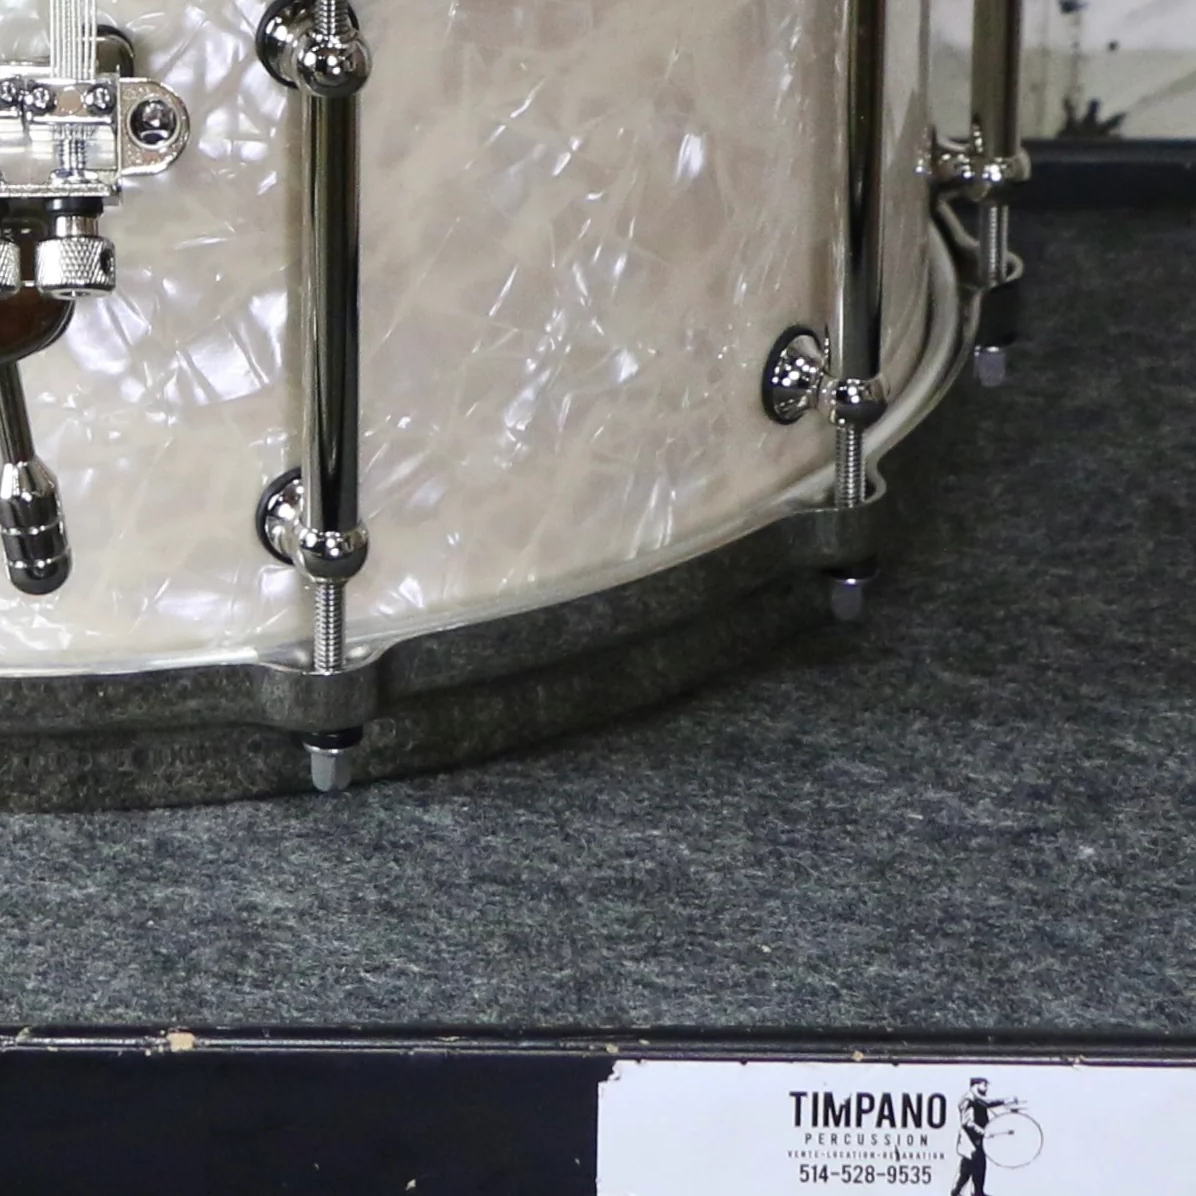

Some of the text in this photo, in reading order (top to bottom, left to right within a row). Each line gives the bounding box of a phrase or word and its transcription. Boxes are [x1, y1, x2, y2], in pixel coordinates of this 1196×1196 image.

[788, 1091, 947, 1129] TIMPANO
[804, 1132, 929, 1146] PERCUSSION
[799, 1164, 932, 1184] 514-528-9535
